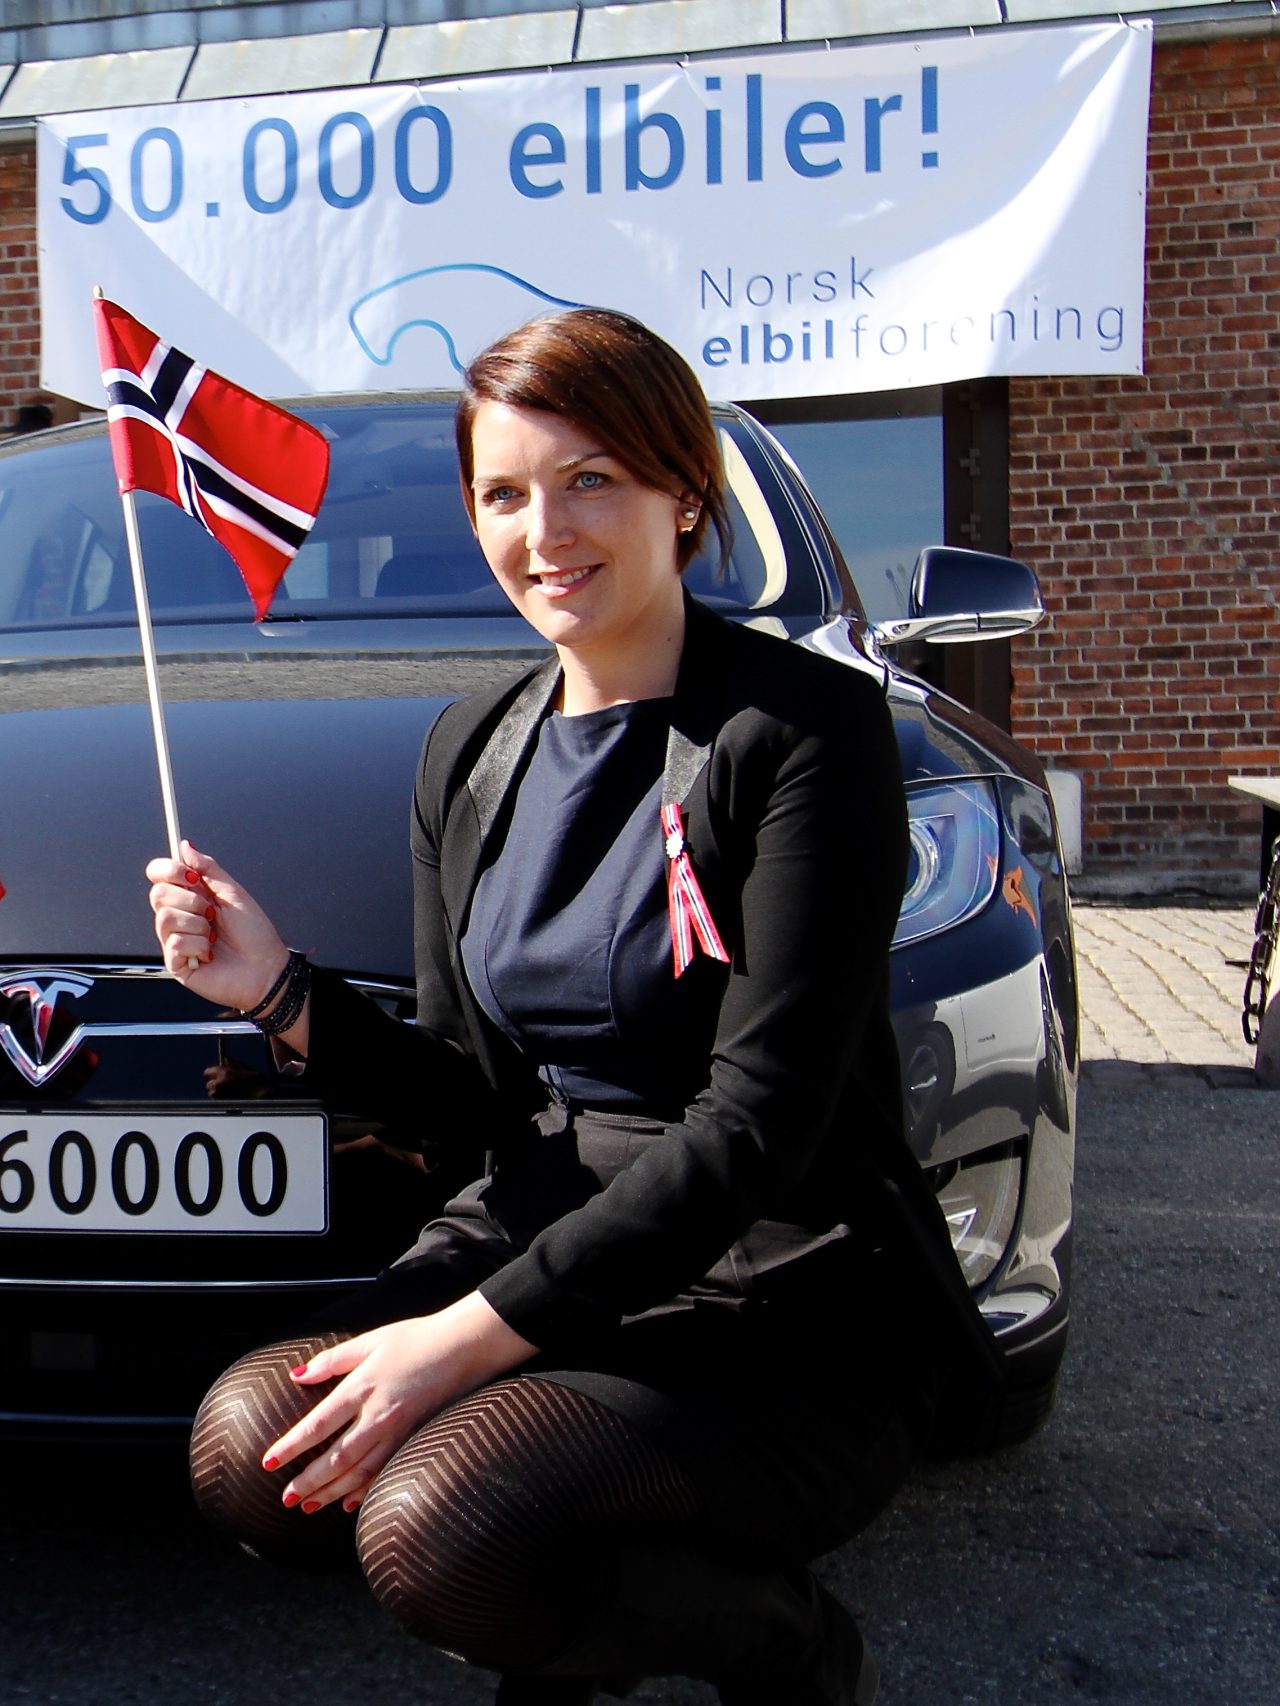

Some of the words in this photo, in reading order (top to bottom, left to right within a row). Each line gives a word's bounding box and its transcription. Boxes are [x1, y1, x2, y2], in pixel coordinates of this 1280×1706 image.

[59, 104, 454, 226] 50.000
[508, 65, 939, 200] elbiler!
[700, 255, 876, 310] Norsk
[701, 295, 1125, 368] elbilforening
